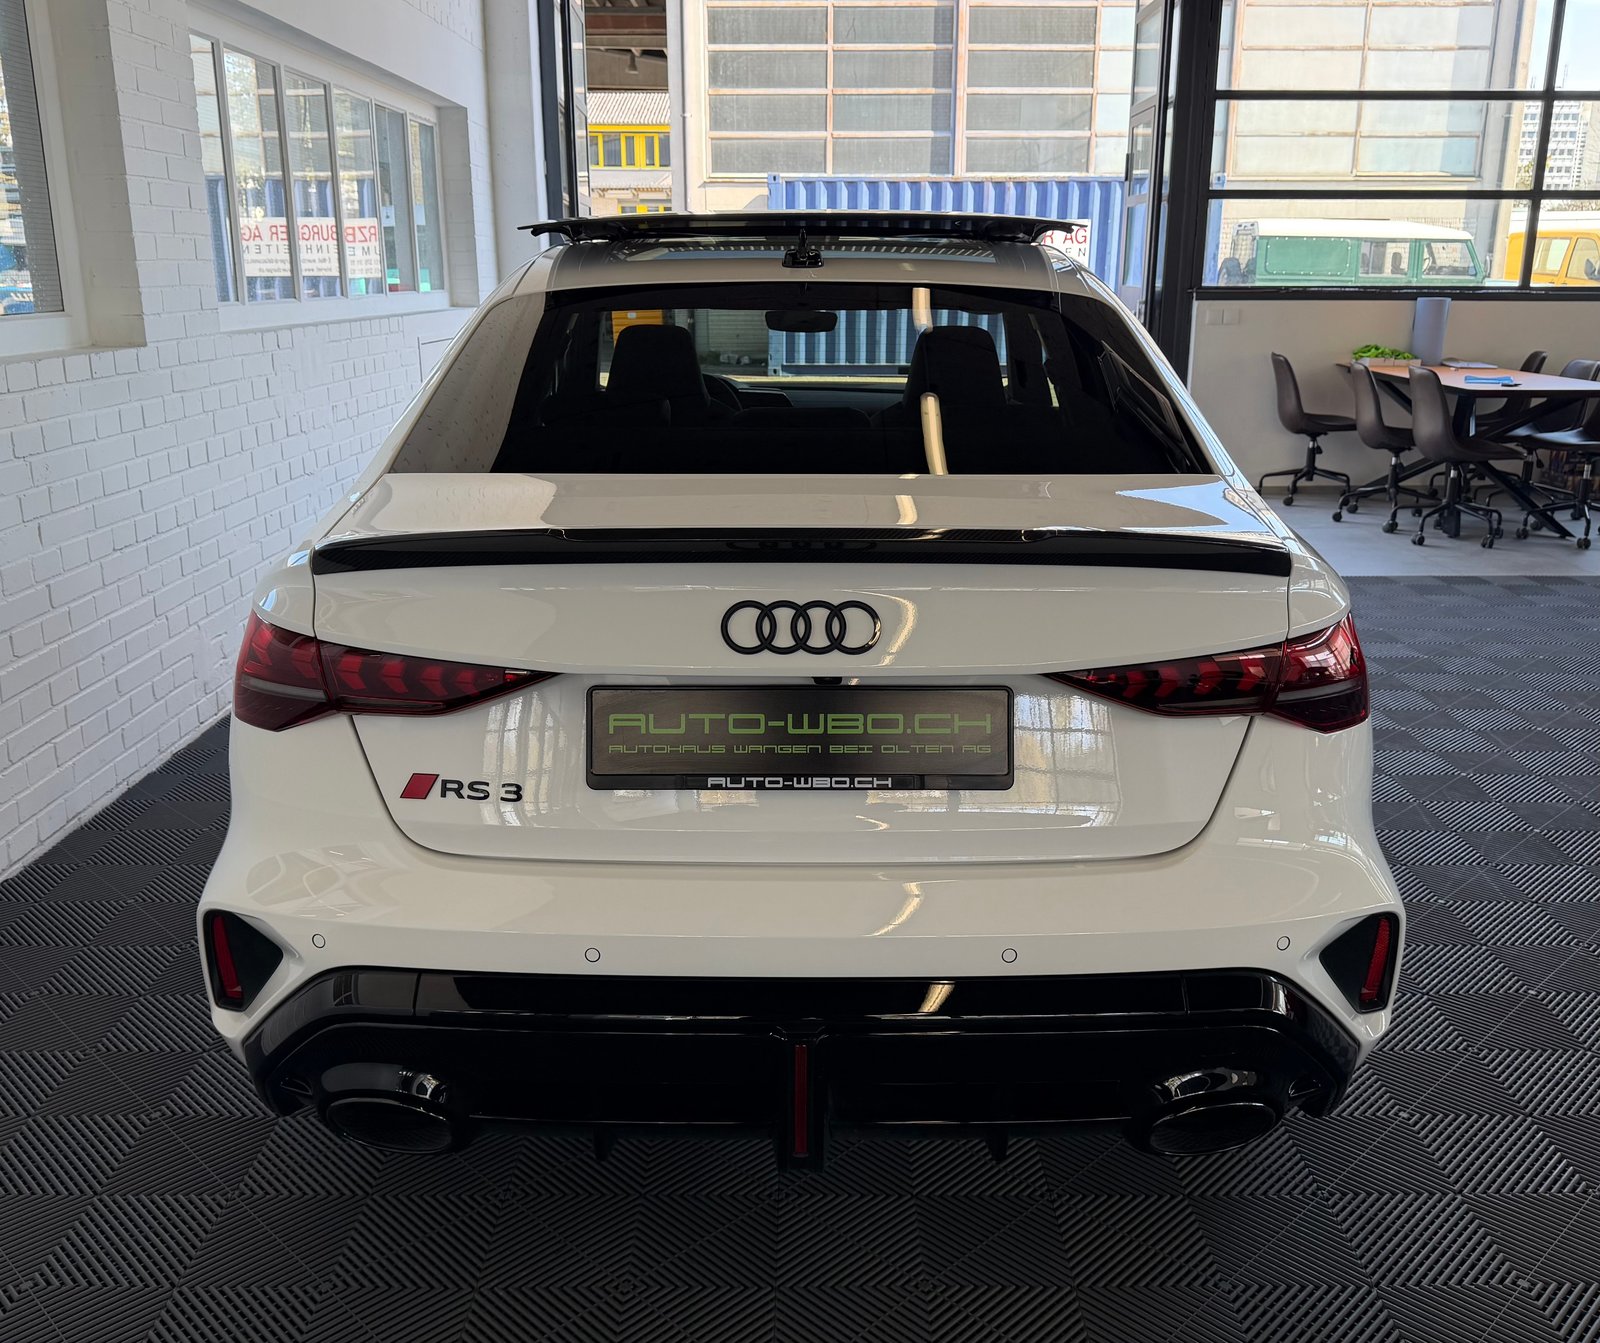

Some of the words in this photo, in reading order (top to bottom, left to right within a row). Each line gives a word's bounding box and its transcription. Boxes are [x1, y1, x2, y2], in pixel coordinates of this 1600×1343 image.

[608, 713, 992, 735] AUTO-WBO.CH
[608, 744, 726, 754] AUTOHAUS
[733, 744, 822, 754] WANGEN
[829, 744, 873, 754] BEI
[880, 744, 954, 754] OLTEN
[962, 744, 992, 754] AG
[707, 776, 892, 788] AUTO-WBO.CH
[440, 779, 490, 801] RS
[500, 783, 523, 803] 3
